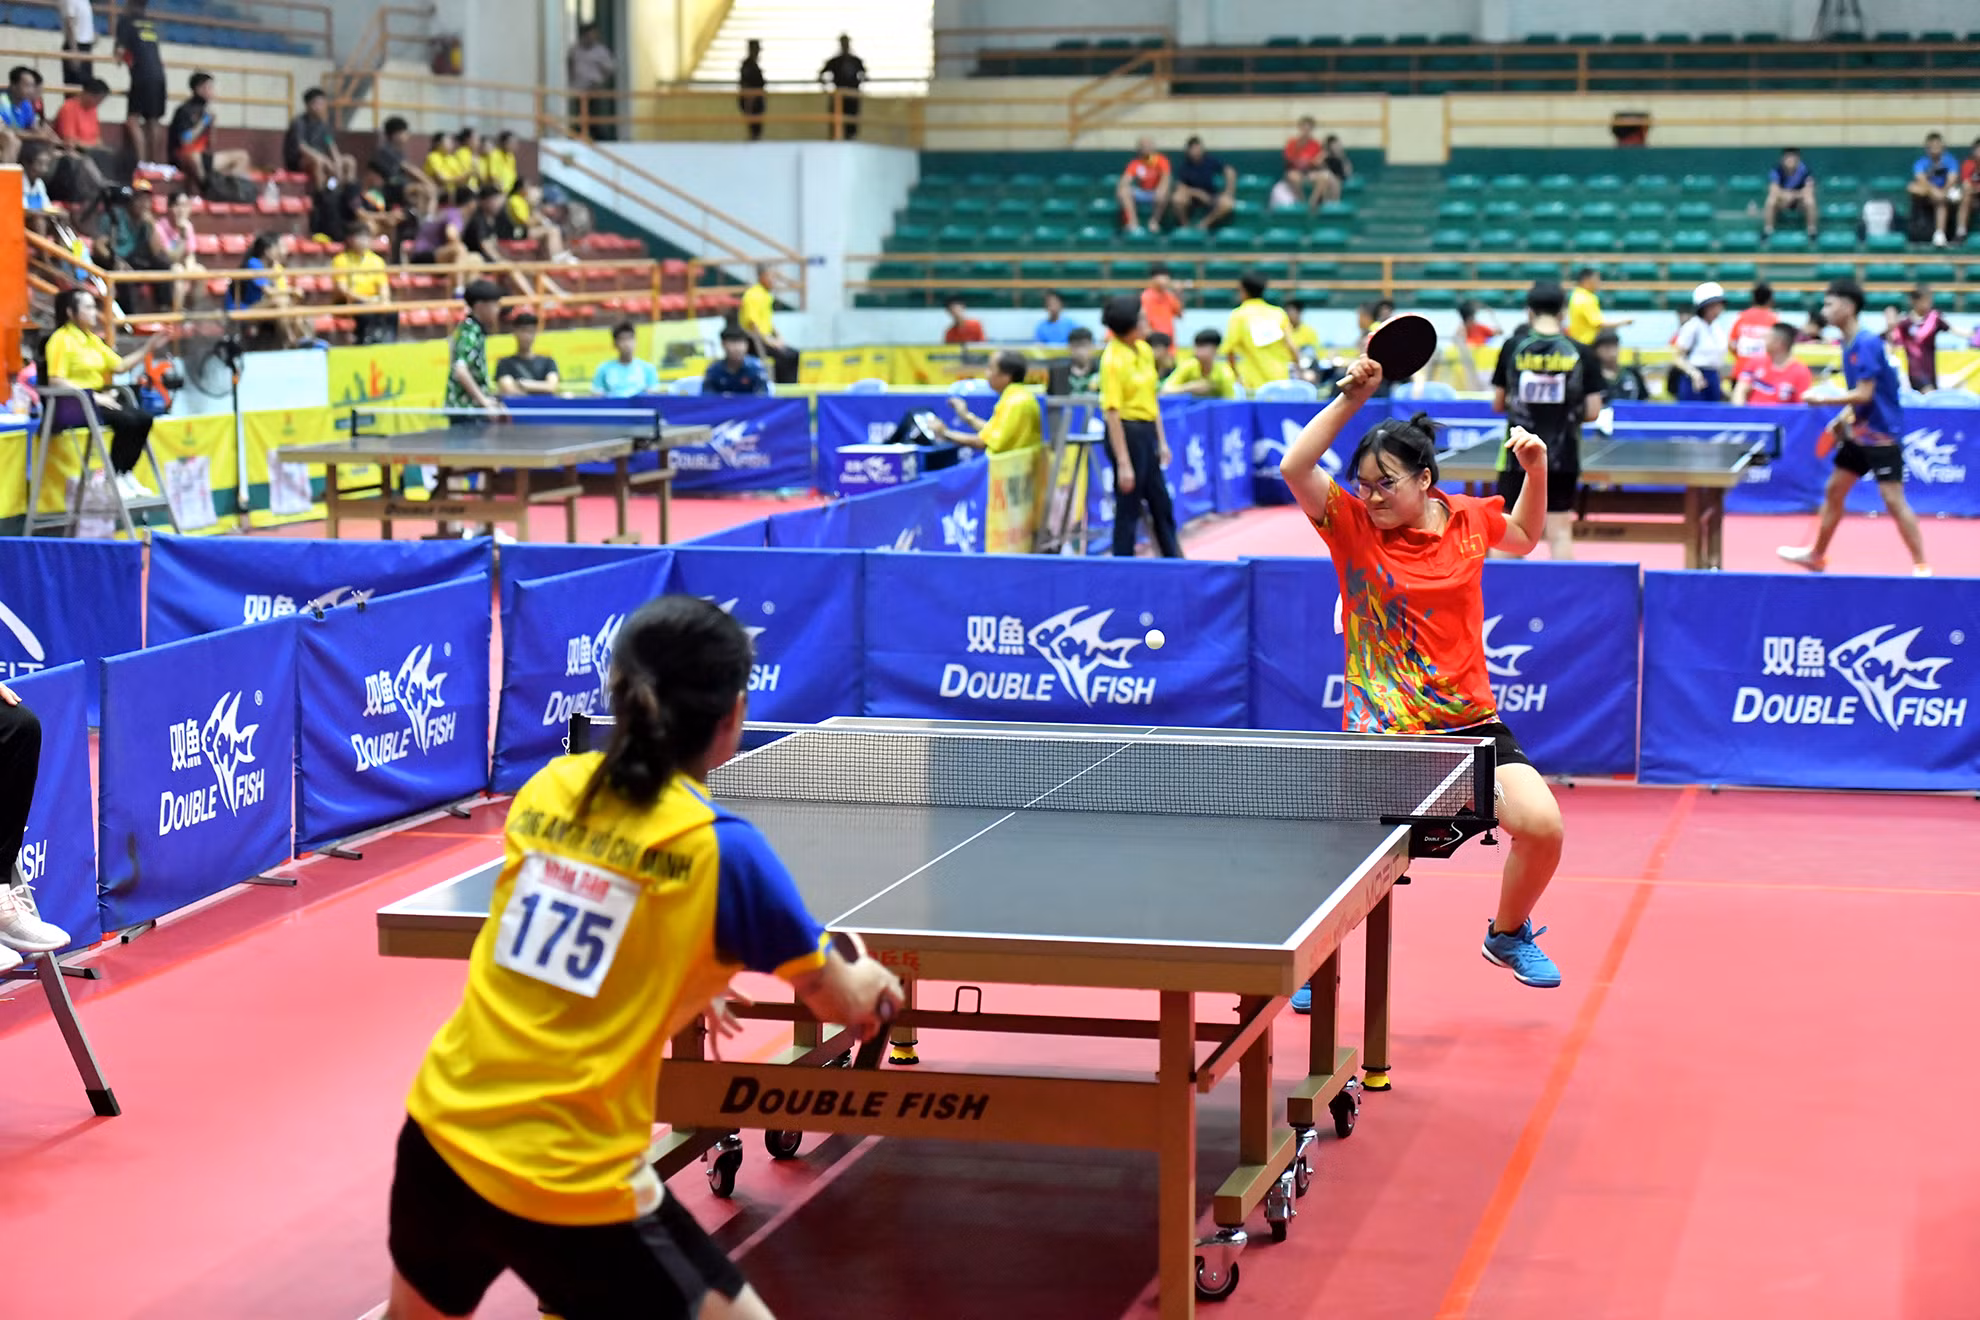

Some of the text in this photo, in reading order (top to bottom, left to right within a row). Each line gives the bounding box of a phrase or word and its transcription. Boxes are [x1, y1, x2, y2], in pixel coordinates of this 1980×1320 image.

[543, 688, 600, 726] DOUBLE
[940, 664, 1157, 705] DOUBLE FISH
[1732, 687, 1968, 727] DOUBLE FISH
[351, 711, 456, 772] DOUBLE FISH
[159, 768, 264, 836] DOUBLE FISH
[510, 893, 614, 980] 175
[720, 1076, 989, 1121] DOUBLE FISH
